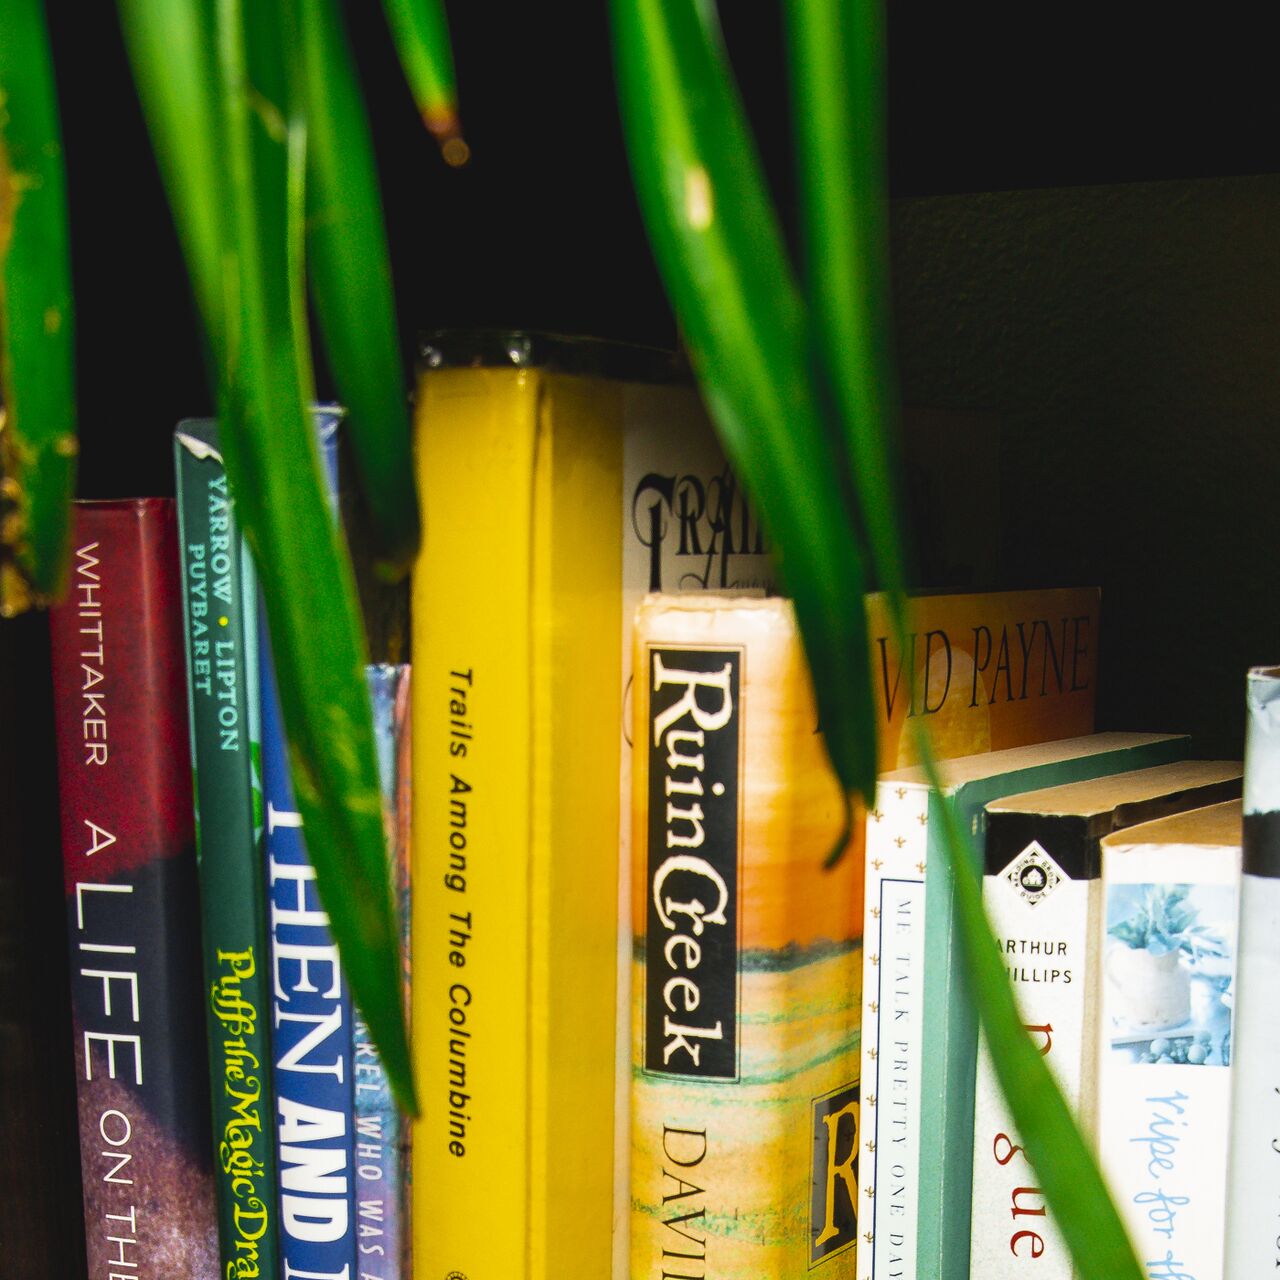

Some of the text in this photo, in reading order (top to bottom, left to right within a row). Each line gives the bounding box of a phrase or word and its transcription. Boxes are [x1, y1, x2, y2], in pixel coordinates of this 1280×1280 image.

[74, 541, 108, 767] WHITTAKER
[188, 544, 212, 696] PUYBARET
[207, 475, 239, 752] YARROW LIPTON
[877, 616, 1090, 722] VID PAYNE
[653, 653, 732, 848] Ruin
[84, 819, 117, 856] A
[445, 667, 474, 1158] Trails Among The Columbine
[653, 855, 727, 1068] Creek
[896, 899, 912, 935] ME
[76, 882, 143, 1085] LIFE
[894, 953, 910, 1021] TALK
[1007, 967, 1072, 983] ILLIPS
[224, 1039, 259, 1079] the
[891, 1041, 909, 1145] PRETTY
[99, 1109, 133, 1185] ON
[219, 1078, 265, 1197] Magic
[277, 1097, 349, 1243] AND
[356, 1117, 382, 1180] WHO
[358, 1200, 384, 1256] WAS
[889, 1165, 906, 1217] ONE
[1133, 1187, 1190, 1241] for
